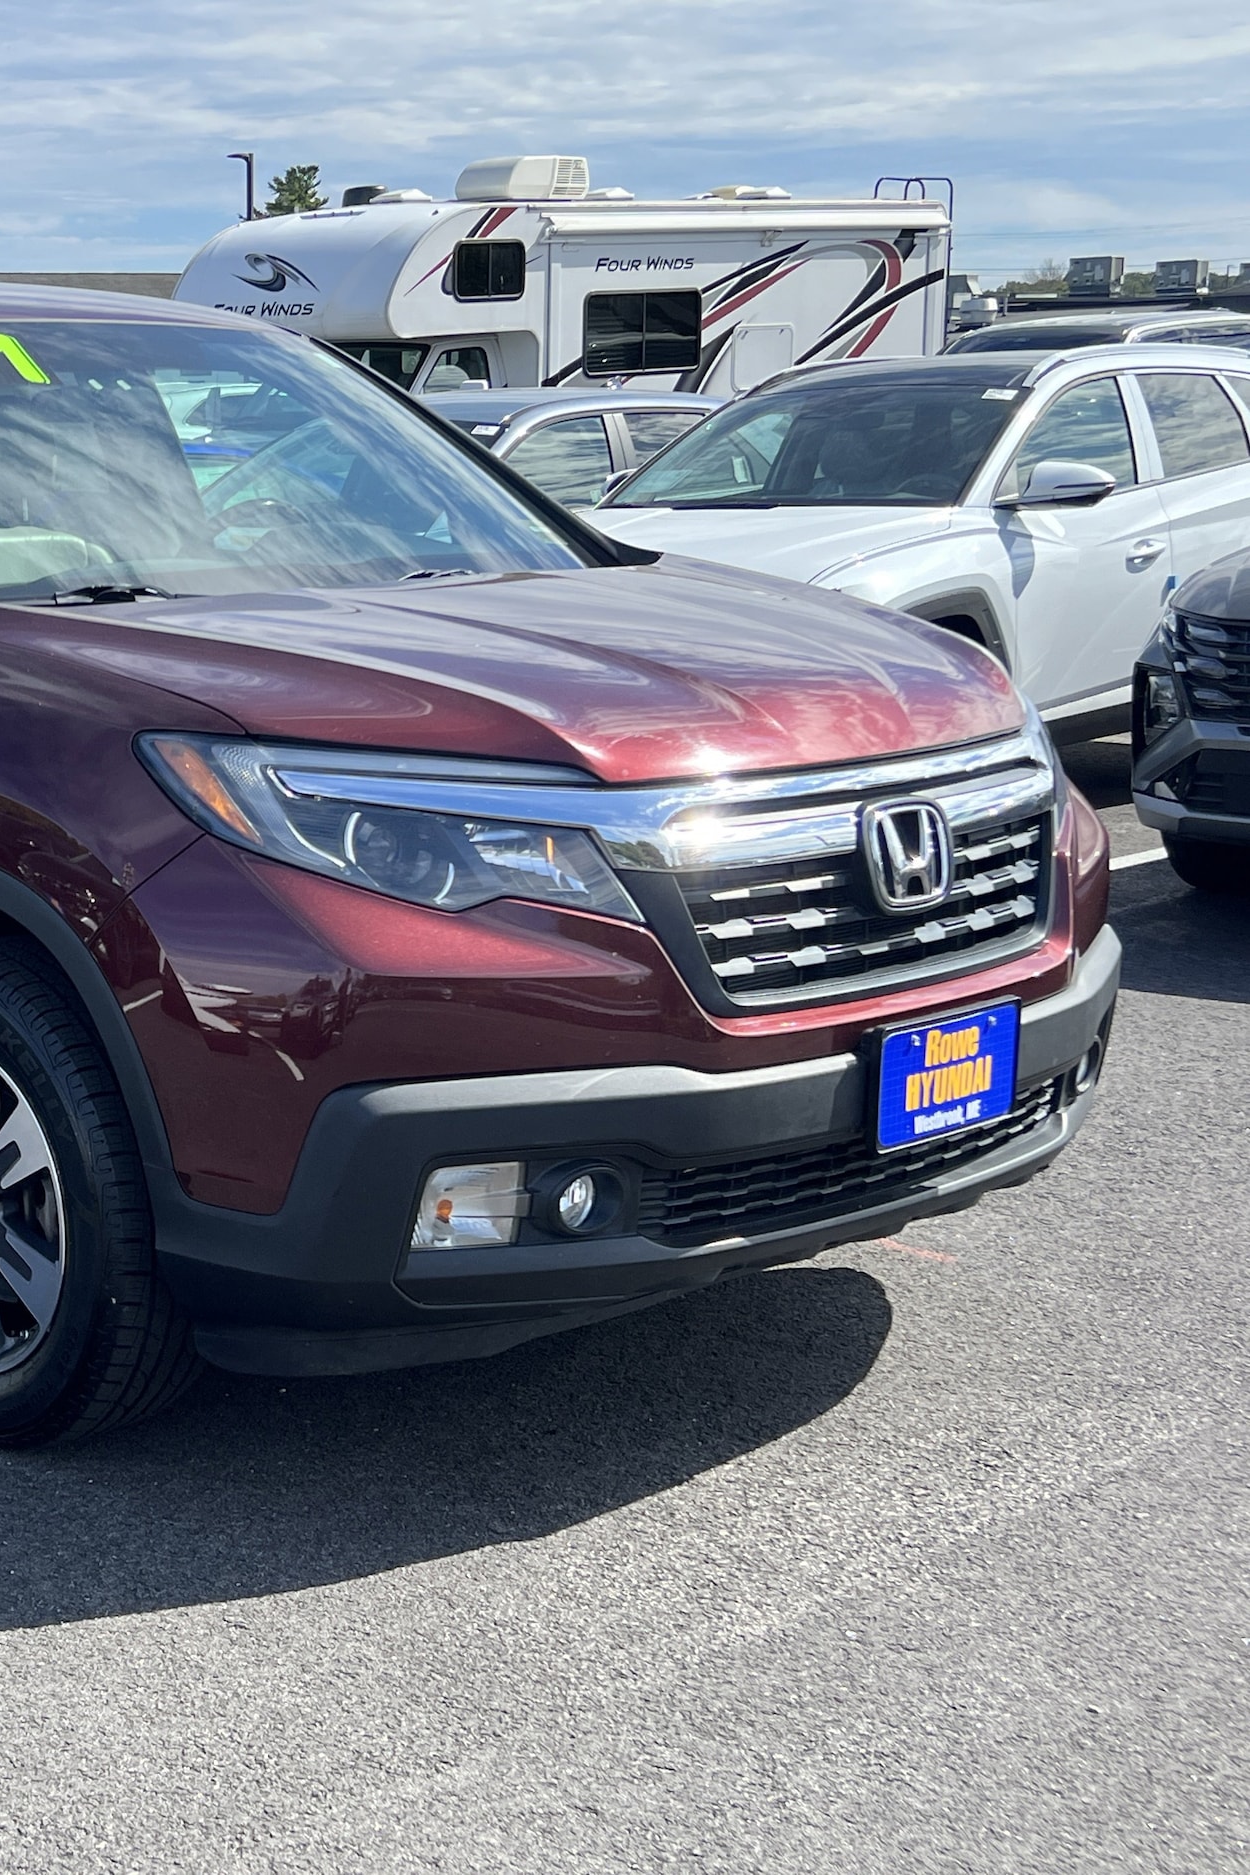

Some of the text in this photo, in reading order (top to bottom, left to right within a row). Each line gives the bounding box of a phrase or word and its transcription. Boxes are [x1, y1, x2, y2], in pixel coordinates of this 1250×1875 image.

[595, 256, 695, 272] FOUR WINDS
[261, 301, 315, 317] WINDS
[925, 1026, 980, 1067] Rowe
[905, 1055, 992, 1112] HYUNDAI
